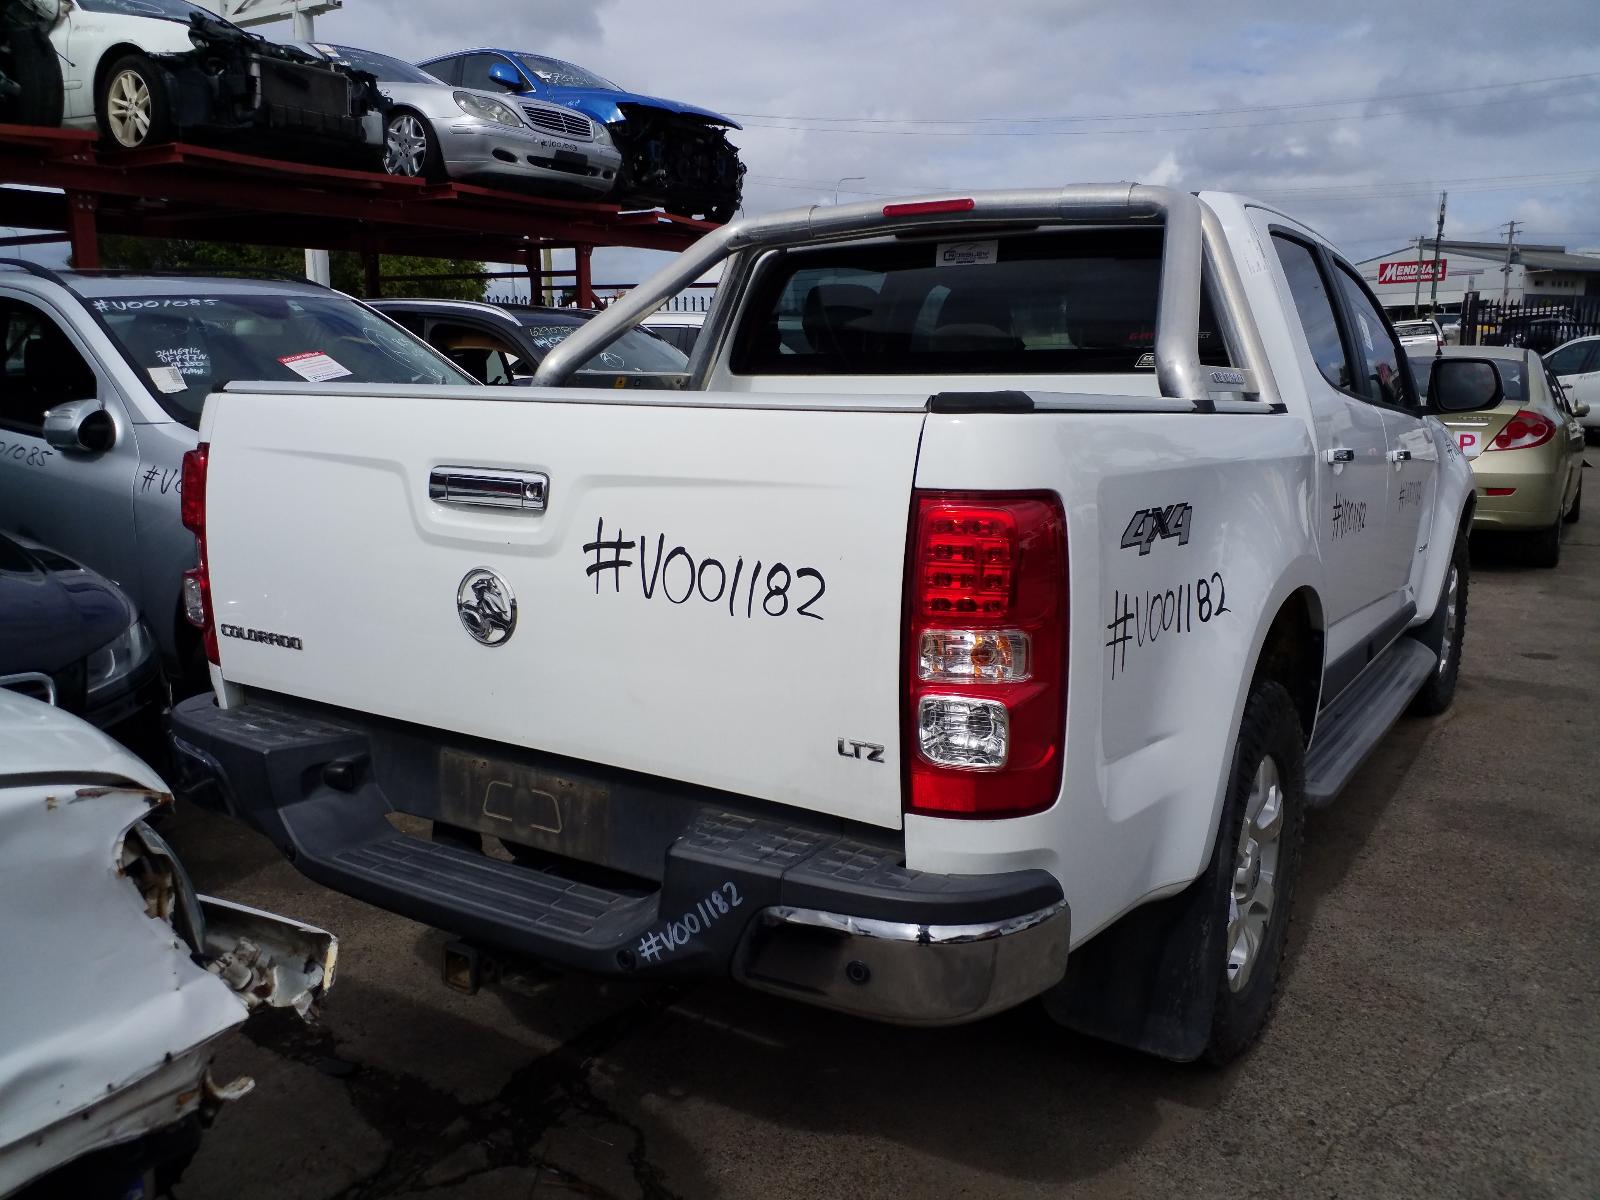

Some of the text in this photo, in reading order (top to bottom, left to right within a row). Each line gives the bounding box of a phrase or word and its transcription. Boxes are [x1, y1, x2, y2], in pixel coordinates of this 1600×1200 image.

[92, 298, 219, 312] #V001085
[1459, 433, 1476, 453] P
[582, 516, 826, 620] #V001182
[220, 623, 304, 650] COLORADO
[1106, 571, 1232, 681] #V001182
[837, 736, 886, 763] LTZ
[638, 881, 744, 962] #V001182
